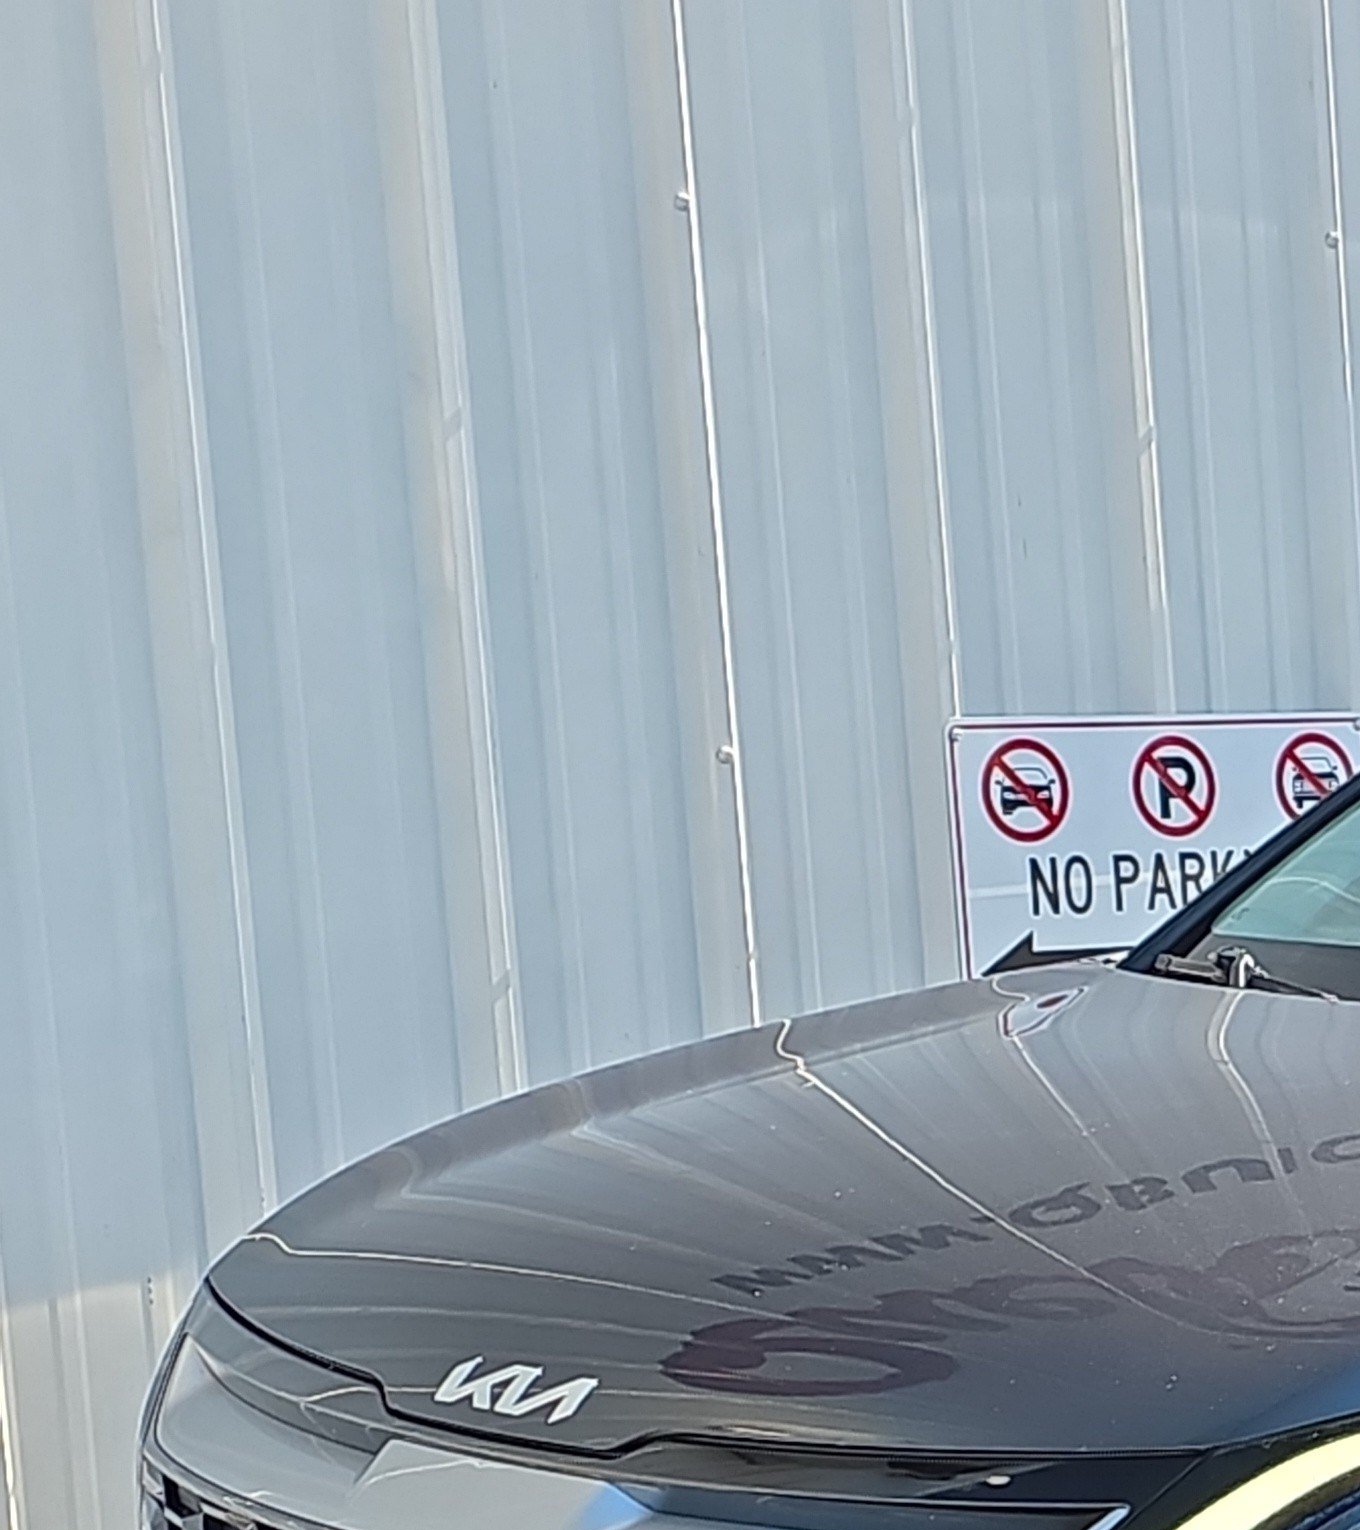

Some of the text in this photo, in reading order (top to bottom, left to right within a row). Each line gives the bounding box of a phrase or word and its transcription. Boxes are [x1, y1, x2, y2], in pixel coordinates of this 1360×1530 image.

[1030, 849, 1252, 916] NO PARK
[433, 1355, 600, 1425] KIA
